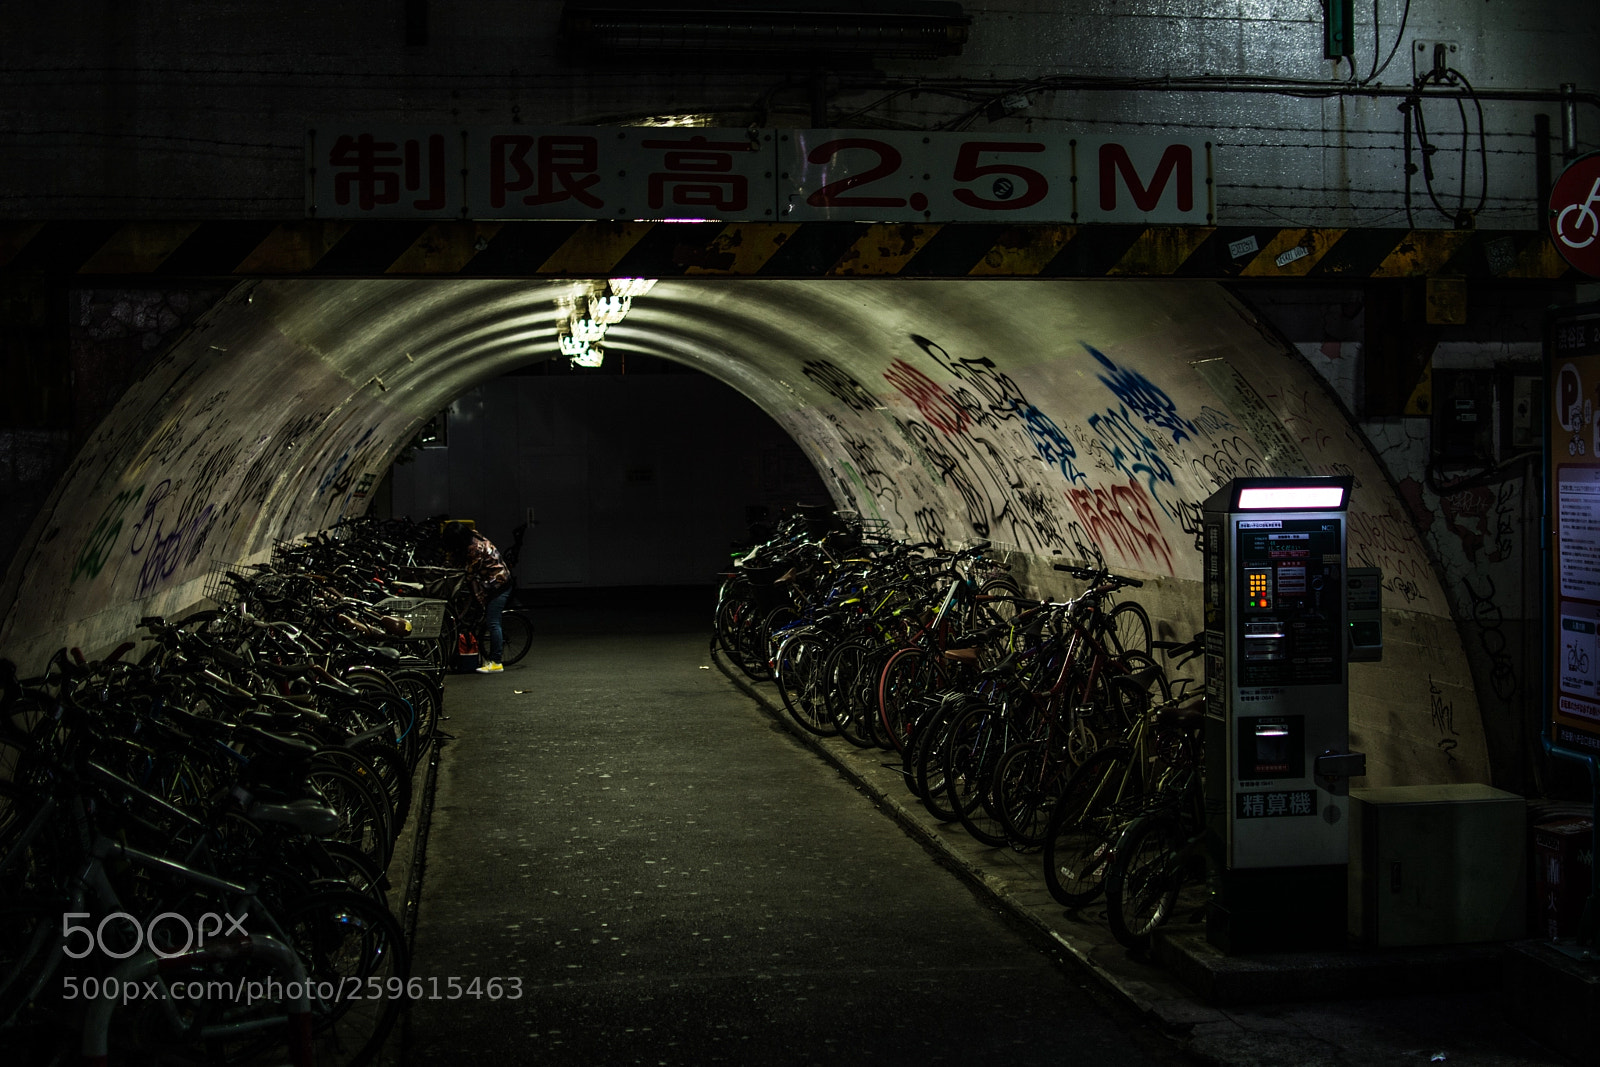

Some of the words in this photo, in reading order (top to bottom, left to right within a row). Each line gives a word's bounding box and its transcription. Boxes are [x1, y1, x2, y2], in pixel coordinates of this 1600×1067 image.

[1562, 370, 1578, 425] P
[1242, 792, 1312, 817] 精算機
